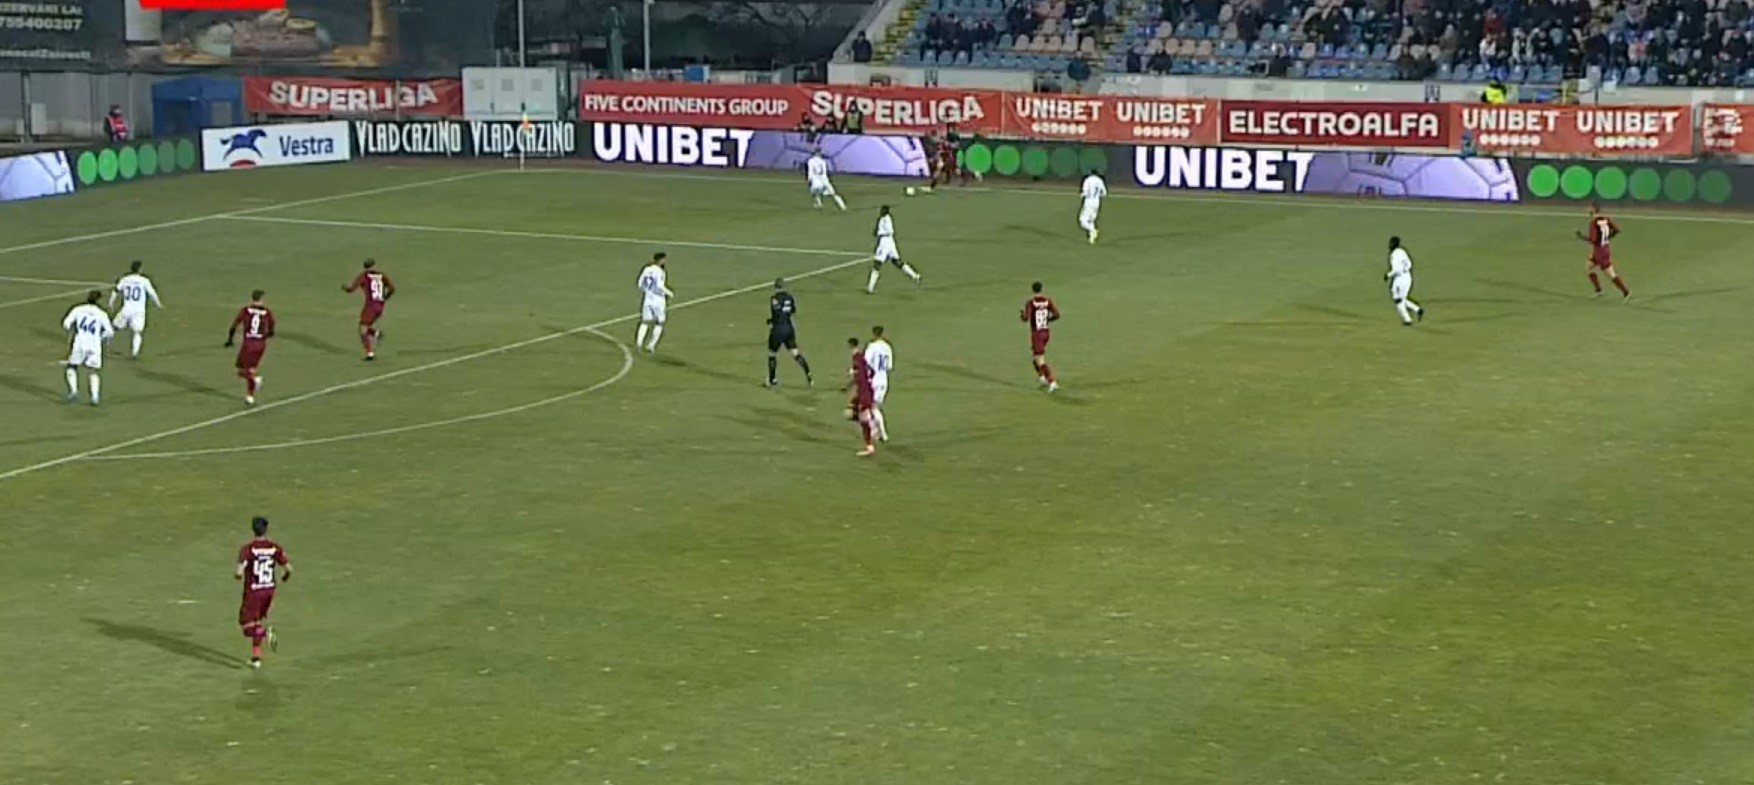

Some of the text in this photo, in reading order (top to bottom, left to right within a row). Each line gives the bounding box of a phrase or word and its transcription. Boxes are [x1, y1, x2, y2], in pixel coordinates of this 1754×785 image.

[271, 80, 439, 112] SUPERLIGA
[584, 94, 789, 116] FIVE CONTINENTS GROUP
[811, 91, 985, 125] SUPERLIGA
[1016, 98, 1103, 121] UNIBET
[1117, 102, 1206, 125] UNIBET
[1461, 108, 1560, 131] UNIBET
[1229, 110, 1439, 137] ELECTROALFA
[1576, 111, 1680, 133] UNIBET
[279, 136, 334, 157] Vestra
[594, 122, 755, 168] UNIBET
[1135, 146, 1316, 192] UNIBET
[79, 316, 96, 335] 44
[252, 559, 275, 583] 45
